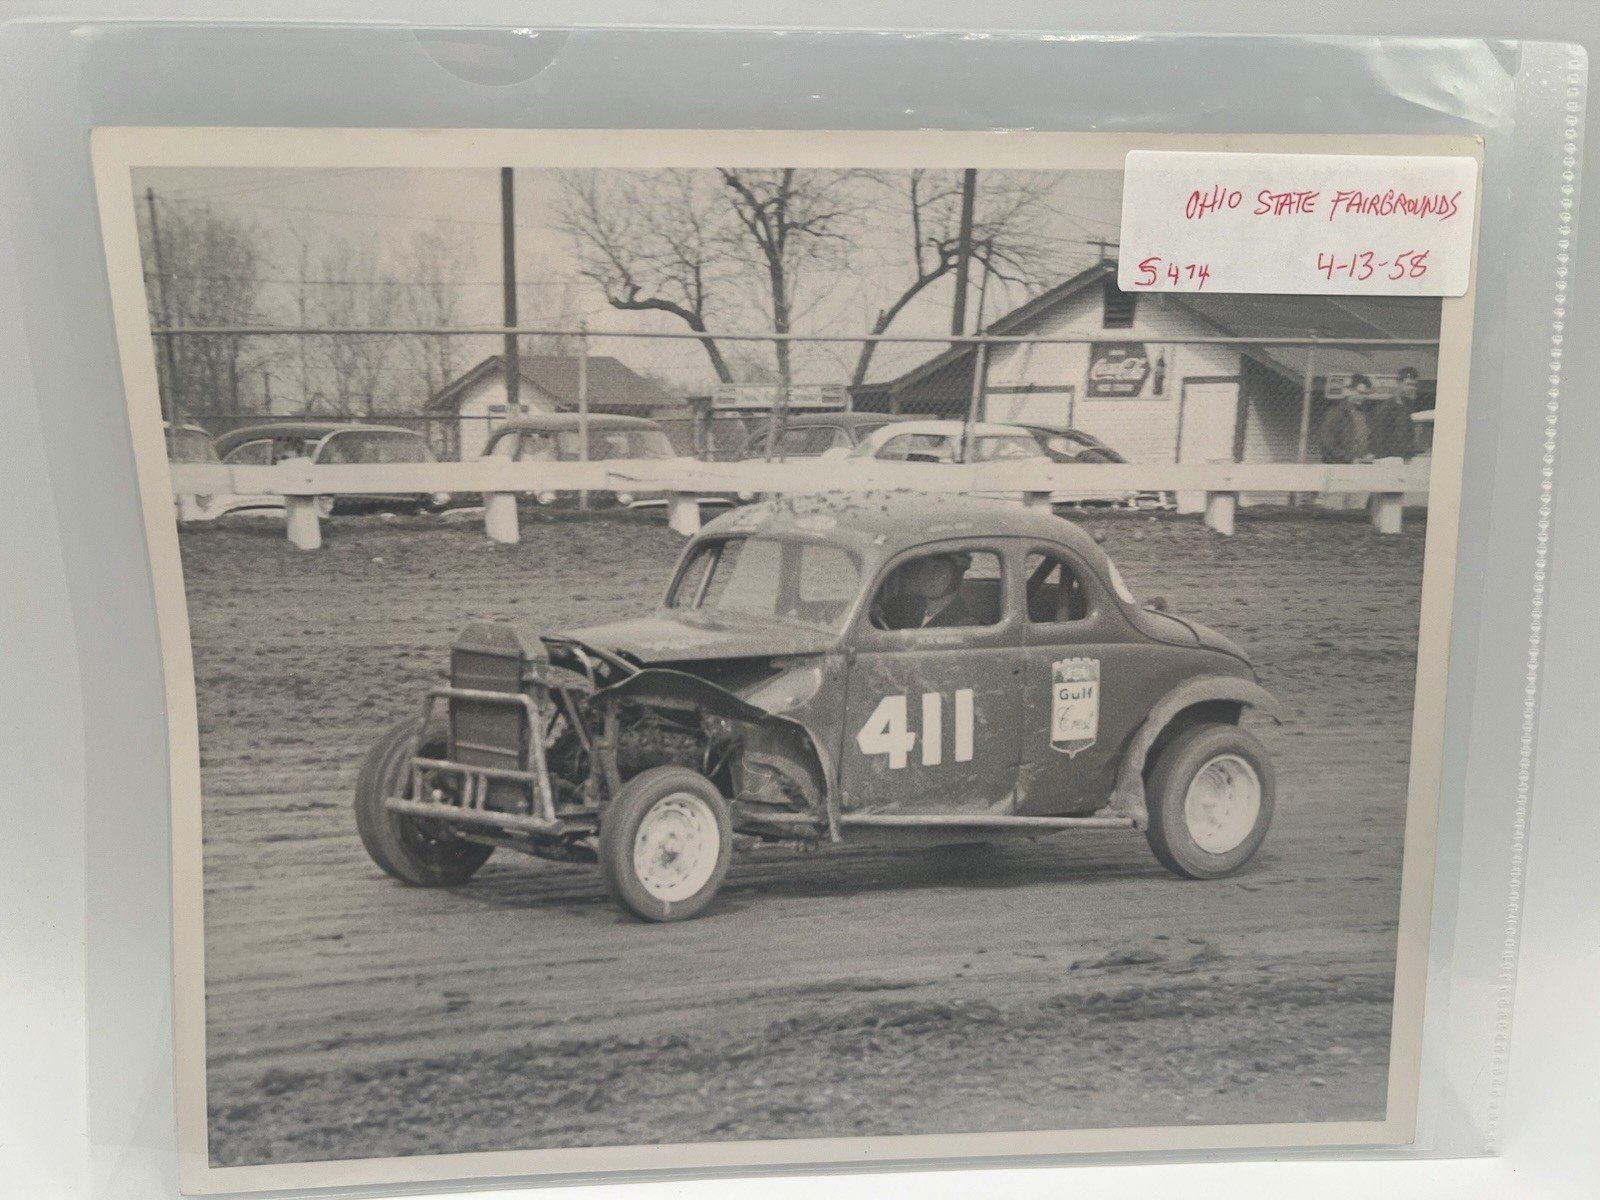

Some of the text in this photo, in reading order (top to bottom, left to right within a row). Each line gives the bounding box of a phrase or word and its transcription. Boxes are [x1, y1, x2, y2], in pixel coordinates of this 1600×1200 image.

[1185, 184, 1462, 221] OHIO STATE FAIRGROUNDS
[1317, 250, 1430, 281] 4-13-58
[1059, 686, 1093, 701] Gulf
[856, 688, 974, 770] 411
